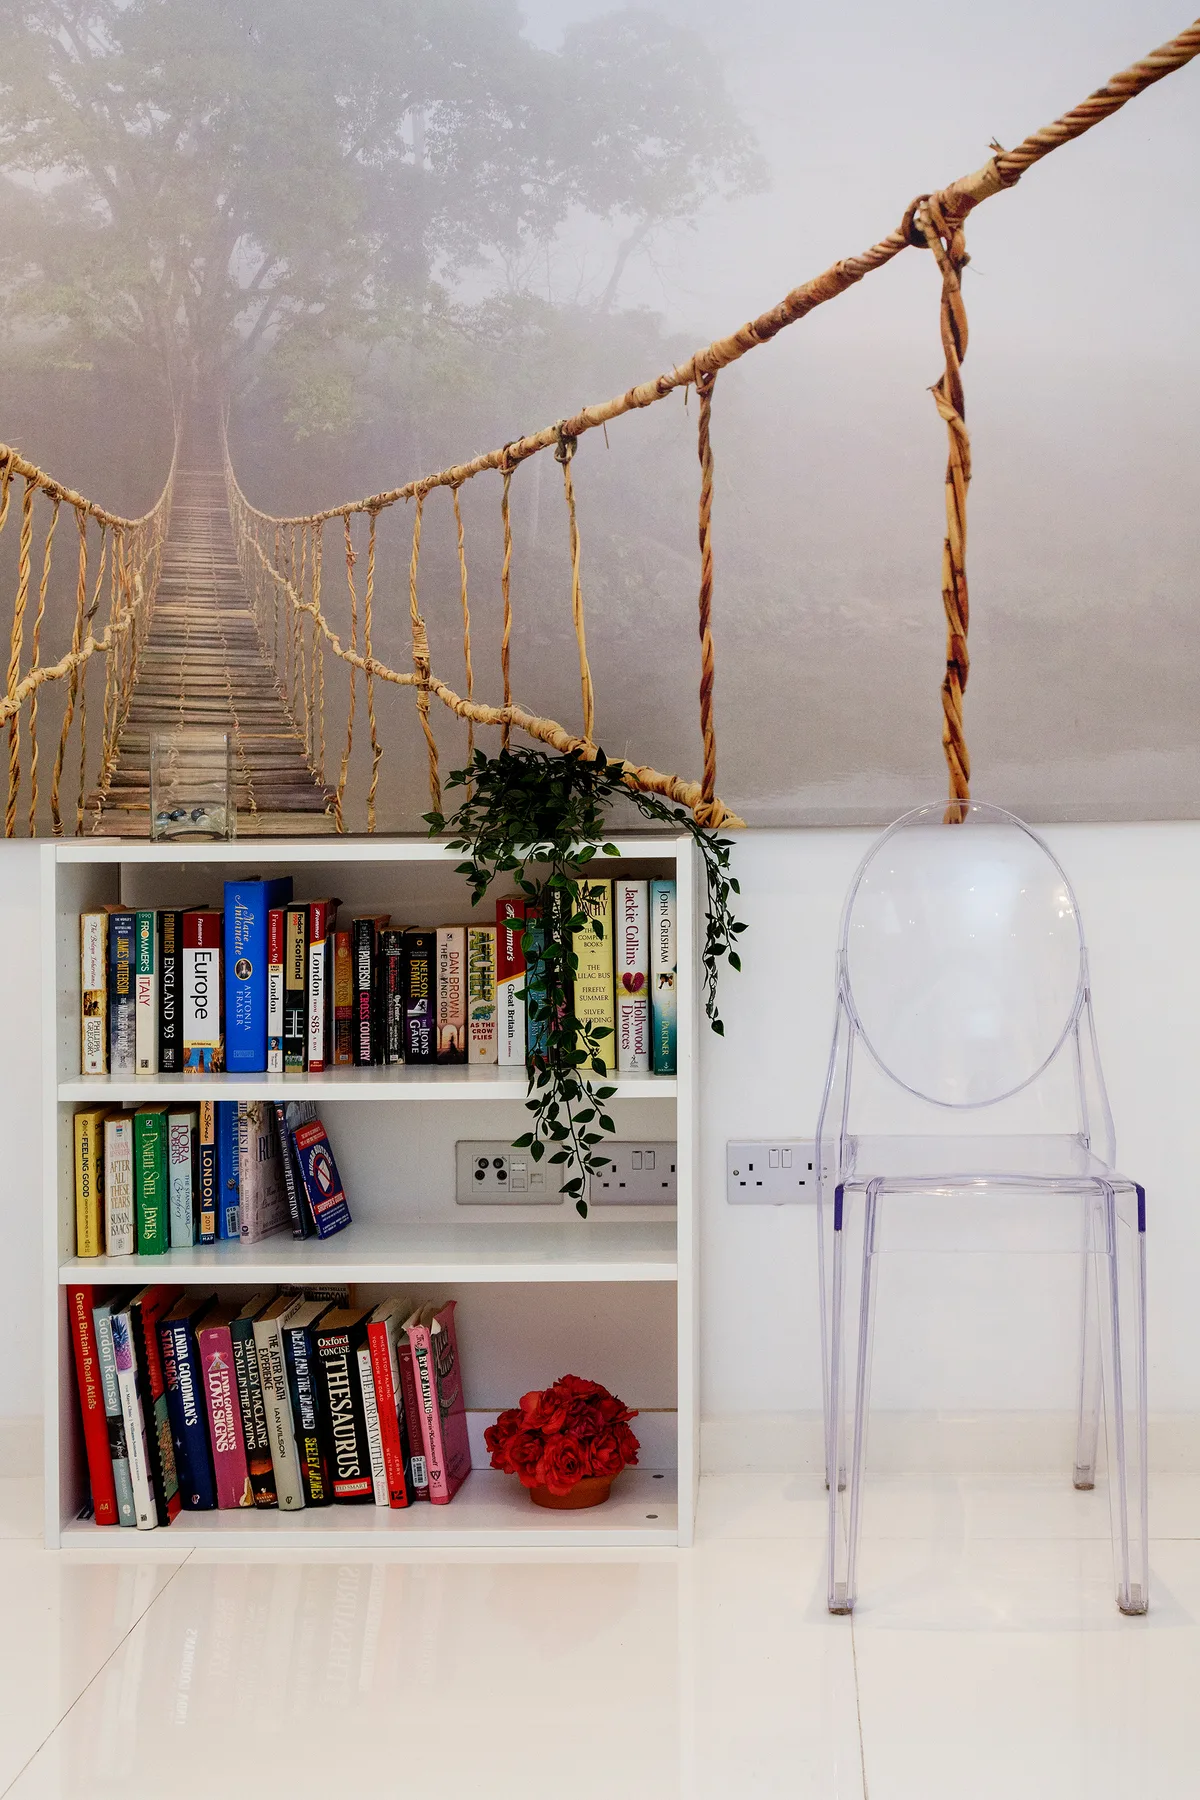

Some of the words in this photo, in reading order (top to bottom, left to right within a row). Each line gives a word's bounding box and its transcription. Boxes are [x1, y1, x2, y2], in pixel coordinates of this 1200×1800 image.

[625, 887, 639, 923] Jackie
[658, 890, 670, 916] JOHN
[234, 894, 249, 956] Antoinette
[243, 911, 255, 942] Marie
[660, 919, 671, 963] GRISHAM
[117, 937, 128, 958] JAMES
[141, 921, 149, 972] FROMMER'S
[272, 953, 278, 963] 96
[295, 938, 303, 980] Scotland
[625, 925, 639, 966] Collins
[117, 960, 129, 995] PATTERSON
[312, 952, 322, 997] London
[358, 951, 371, 990] PATTERSON
[420, 959, 428, 998] NELSON
[441, 962, 448, 973] DA
[449, 952, 459, 974] DAN
[469, 930, 496, 1005] ARCHER
[139, 976, 150, 1007] ITALY
[164, 957, 175, 1020] ENGLAND
[190, 951, 212, 1020] Europe
[270, 974, 280, 1014] London
[449, 977, 459, 1018] BROWN
[507, 984, 515, 1007] Great
[236, 990, 244, 1026] FRASER
[360, 992, 370, 1020] CROSS
[577, 1016, 612, 1024] WEDDING
[311, 1016, 320, 1034] $85
[410, 1020, 421, 1054] GAME
[507, 1010, 515, 1038] Britain
[622, 1005, 633, 1050] Divorces
[634, 1000, 646, 1055] Hollywood
[661, 1020, 670, 1056] PARTNER
[360, 1022, 371, 1061] COUNTRY
[419, 1027, 430, 1055] LION'S
[142, 1133, 158, 1169] DANIELLE
[171, 1125, 181, 1165] ROBERTS
[178, 1125, 189, 1164] NORA
[110, 1159, 131, 1174] AFTER
[115, 1173, 125, 1184] ALL
[203, 1150, 213, 1207] LONDON
[285, 1170, 294, 1191] PETER
[82, 1173, 90, 1198] GOOD
[111, 1185, 130, 1196] THESE
[143, 1171, 159, 1199] STEEL
[111, 1196, 131, 1210] YEARS
[111, 1212, 129, 1225] SUSAN
[288, 1192, 299, 1219] USTINOV
[142, 1203, 158, 1240] JEWELS
[75, 1292, 86, 1320] Great
[78, 1322, 91, 1354] Britain
[98, 1318, 112, 1362] Gordon
[161, 1329, 173, 1357] STAR
[173, 1327, 188, 1360] LINDA
[268, 1334, 278, 1348] THE
[291, 1330, 305, 1355] DEATH
[317, 1335, 349, 1348] Oxford
[319, 1347, 350, 1356] CONCISE
[84, 1356, 94, 1383] Road
[235, 1358, 246, 1375] ALL
[244, 1338, 259, 1386] SHIRLEY
[258, 1347, 273, 1390] EXPERIENCE
[270, 1350, 282, 1374] AFTER
[294, 1357, 307, 1372] AND
[414, 1346, 428, 1368] ART
[103, 1364, 119, 1412] Ramsay
[164, 1360, 179, 1392] SIGNS
[208, 1373, 224, 1408] LOVE
[220, 1371, 230, 1397] LINDA
[238, 1376, 247, 1387] IN
[273, 1376, 286, 1401] DEATH
[298, 1374, 310, 1391] THE
[361, 1366, 373, 1389] THE
[420, 1369, 429, 1381] OF
[86, 1384, 96, 1410] Atlas
[178, 1363, 198, 1427] GOODMAN'S
[239, 1388, 250, 1407] THE
[422, 1382, 433, 1414] LIVING
[222, 1398, 236, 1450] GOODMAN'S
[251, 1389, 268, 1448] MACLAINE
[300, 1393, 315, 1430] DAMNED
[325, 1354, 361, 1478] THESAURUS
[363, 1391, 379, 1432] HAREM
[212, 1410, 228, 1453] SIGNS
[242, 1409, 256, 1450] PLAYING
[275, 1424, 286, 1458] WILSON
[304, 1437, 320, 1468] SEELEY
[369, 1433, 385, 1478] WITHIN
[386, 1447, 394, 1485] WEINTRAUB
[309, 1471, 323, 1500] JAMES
[347, 1482, 367, 1491] SMART
